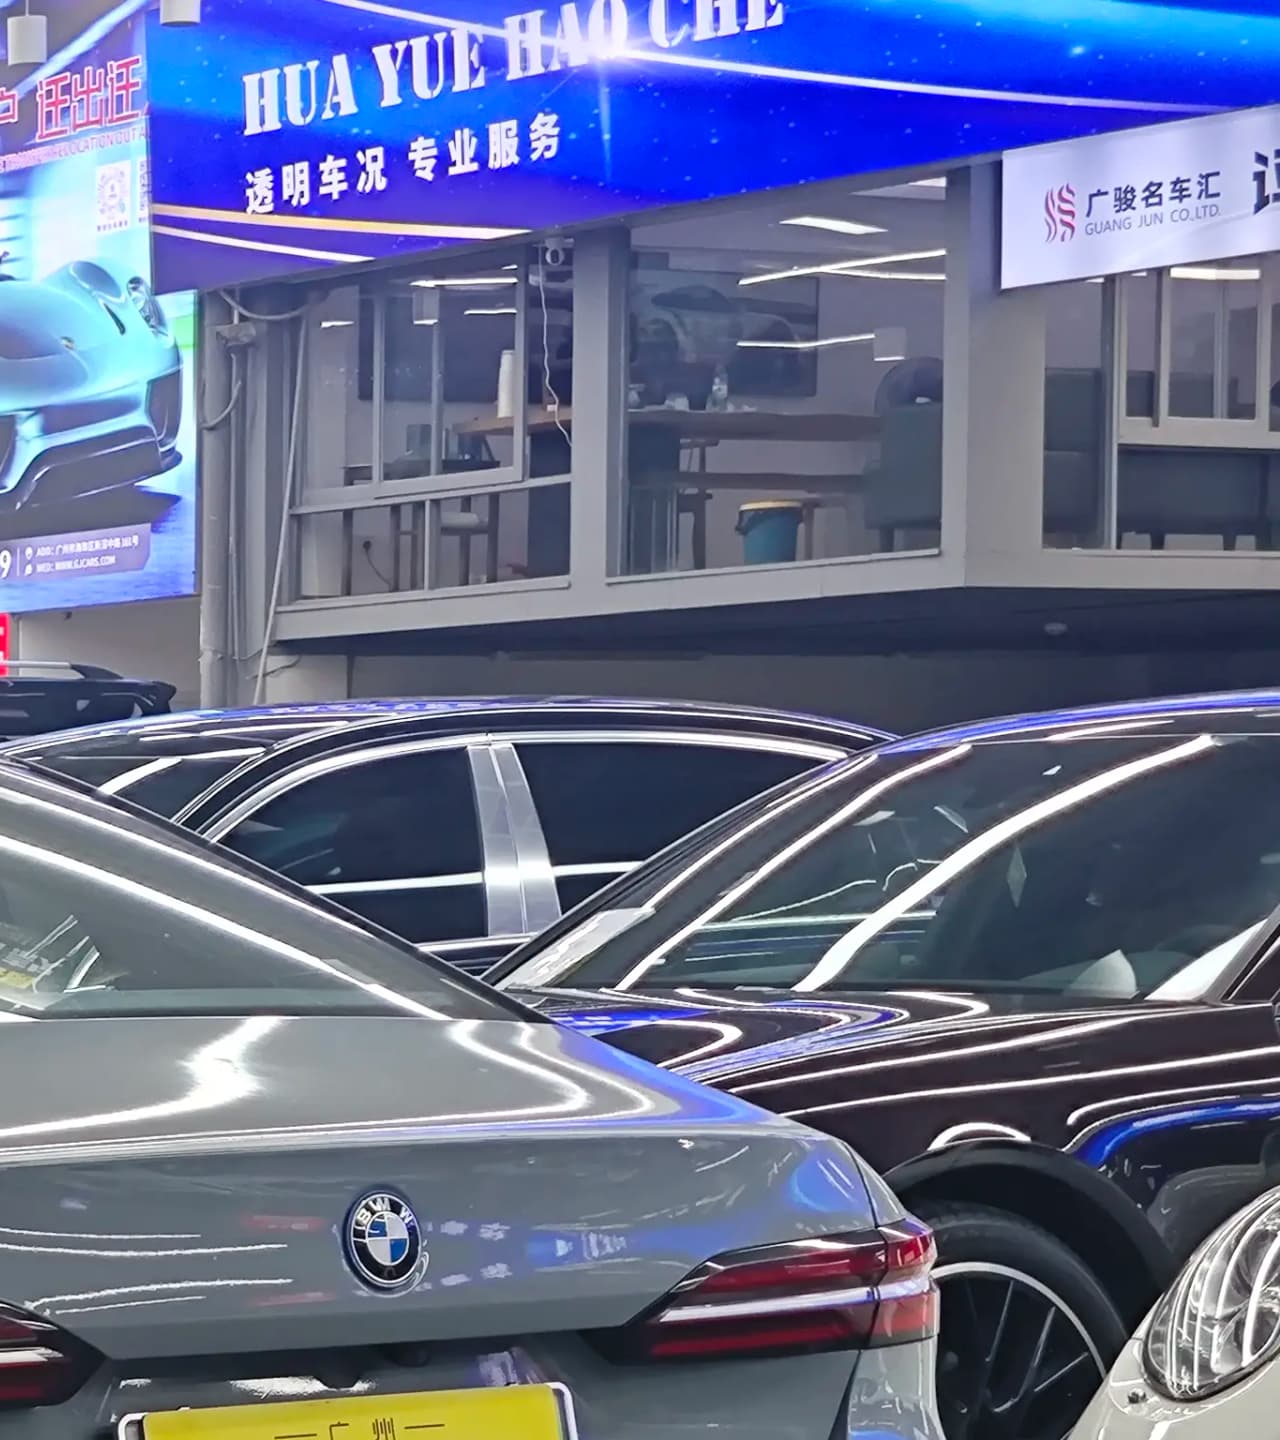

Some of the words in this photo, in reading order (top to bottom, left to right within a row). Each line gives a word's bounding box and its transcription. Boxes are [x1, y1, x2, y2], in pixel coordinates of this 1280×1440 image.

[35, 54, 150, 143] 迁出迁
[243, 53, 359, 137] HUA
[372, 24, 487, 108] YUE
[504, 0, 630, 83] HAO
[244, 146, 389, 217] 透明车况
[408, 112, 562, 185] 专业服务
[1085, 170, 1222, 218] 广骏名车汇
[1084, 217, 1133, 236] GUANG
[1138, 212, 1164, 229] JUN
